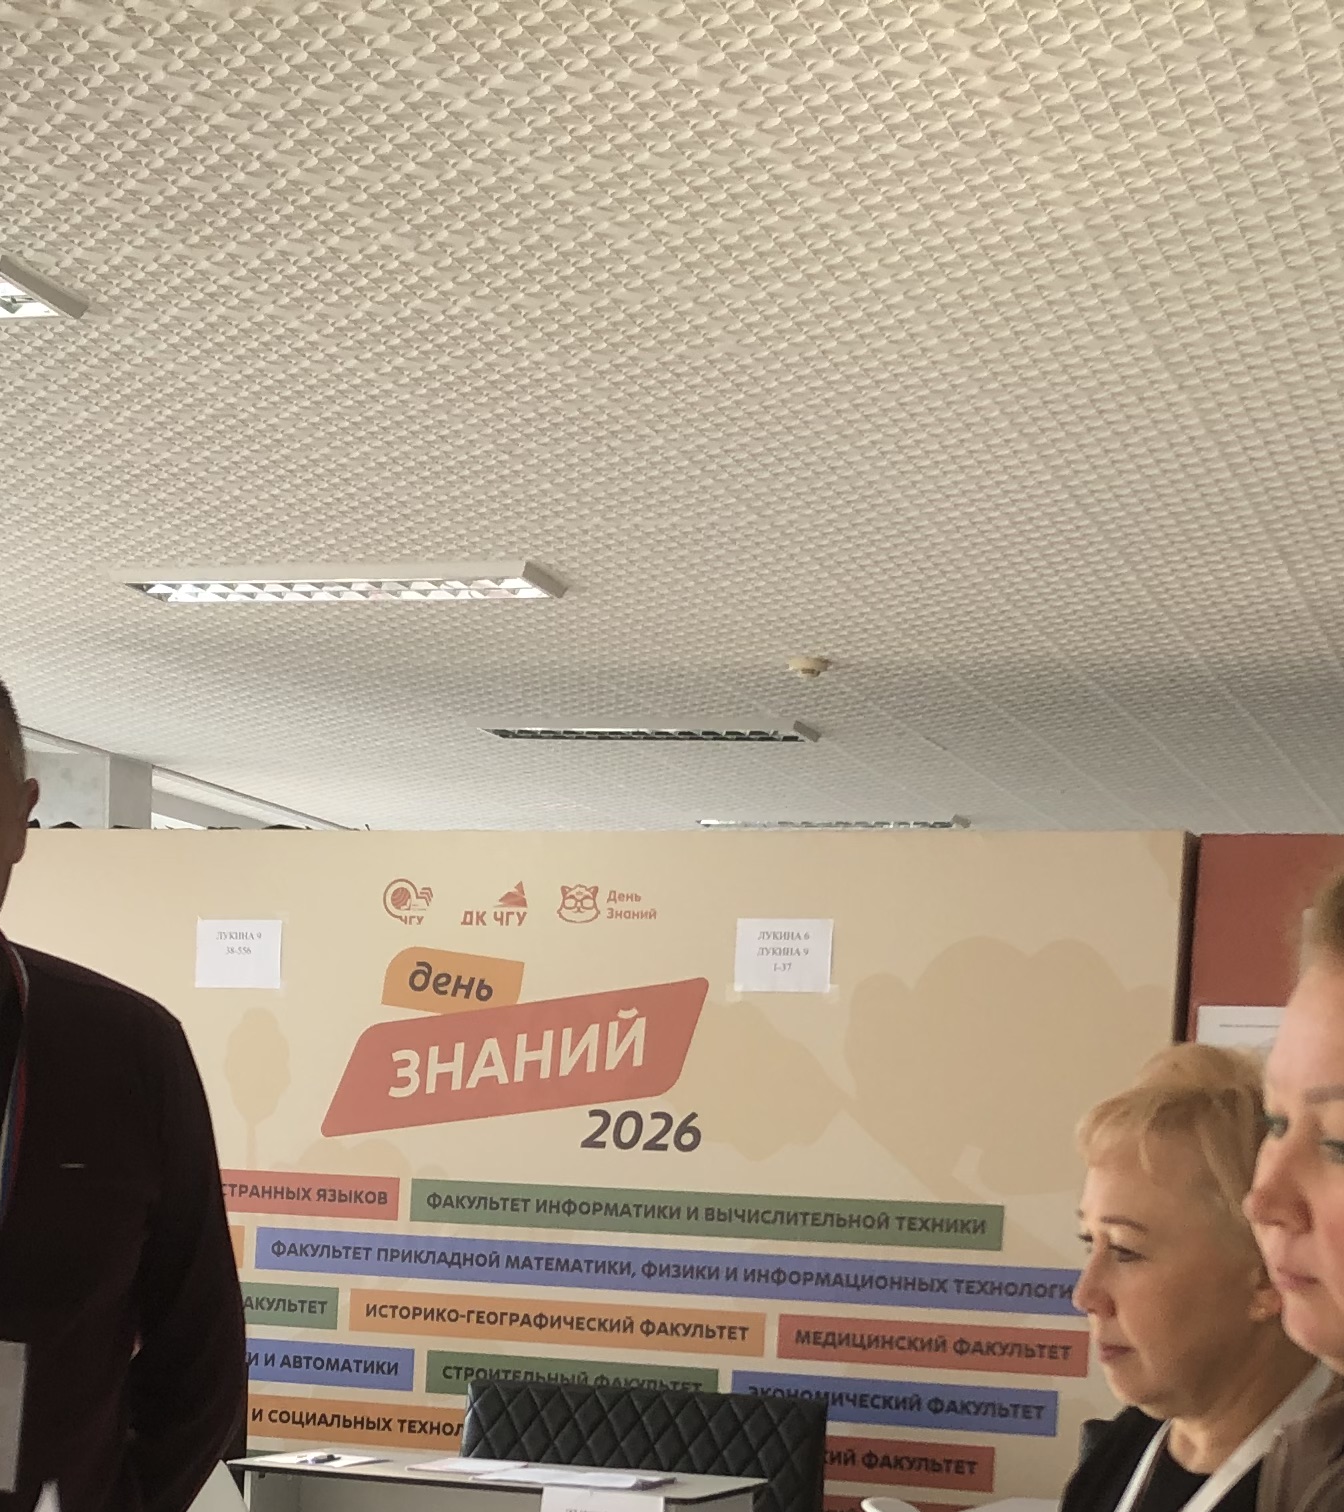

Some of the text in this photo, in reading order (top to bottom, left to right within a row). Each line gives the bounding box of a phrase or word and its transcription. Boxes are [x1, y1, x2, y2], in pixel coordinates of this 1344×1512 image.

[606, 889, 642, 904] День
[460, 910, 528, 927] ДК ЧГУ
[606, 907, 658, 921] Знаний
[216, 931, 255, 940] ЛУКИНА
[757, 931, 802, 941] ЛУКИНА
[756, 947, 801, 957] ЛУКИНА
[408, 960, 494, 1003] день
[387, 1006, 647, 1099] ЗНАНИЙ
[579, 1109, 703, 1153] 2026
[315, 1187, 389, 1205] ЯЗЫКОВ
[426, 1191, 987, 1235] ФАКУЛЬТЕТ ИНФОРМАТИКИ И ВЫЧИСЛИТЕЛЬНОЙ ТЕХНИКИ
[271, 1239, 373, 1262] ФАКУЛЬТЕТ
[377, 1247, 501, 1271] ПРИКЛАДНОЙ
[505, 1254, 637, 1280] МАТЕМАТИКИ,
[641, 1261, 720, 1282] ФИЗИКИ
[724, 1266, 738, 1283] И
[743, 1266, 949, 1294] ИНФОРМАЦИОННЫХ
[365, 1302, 750, 1342] ИСТОРИКО-ГЕОГРАФИЧЕСКИЙ ФАКУЛЬТЕТ
[794, 1328, 1073, 1361] МЕДИЦИНСКИЙ ФАКУЛЬТЕТ
[264, 1352, 276, 1367] И
[279, 1354, 399, 1376] АВТОМАТИКИ
[251, 1408, 264, 1423] И
[268, 1409, 393, 1432] СОЦИАЛЬНЫХ
[927, 1395, 1045, 1421] ФАКУЛЬТЕТ
[861, 1450, 978, 1475] ФАКУЛЬТЕТ
